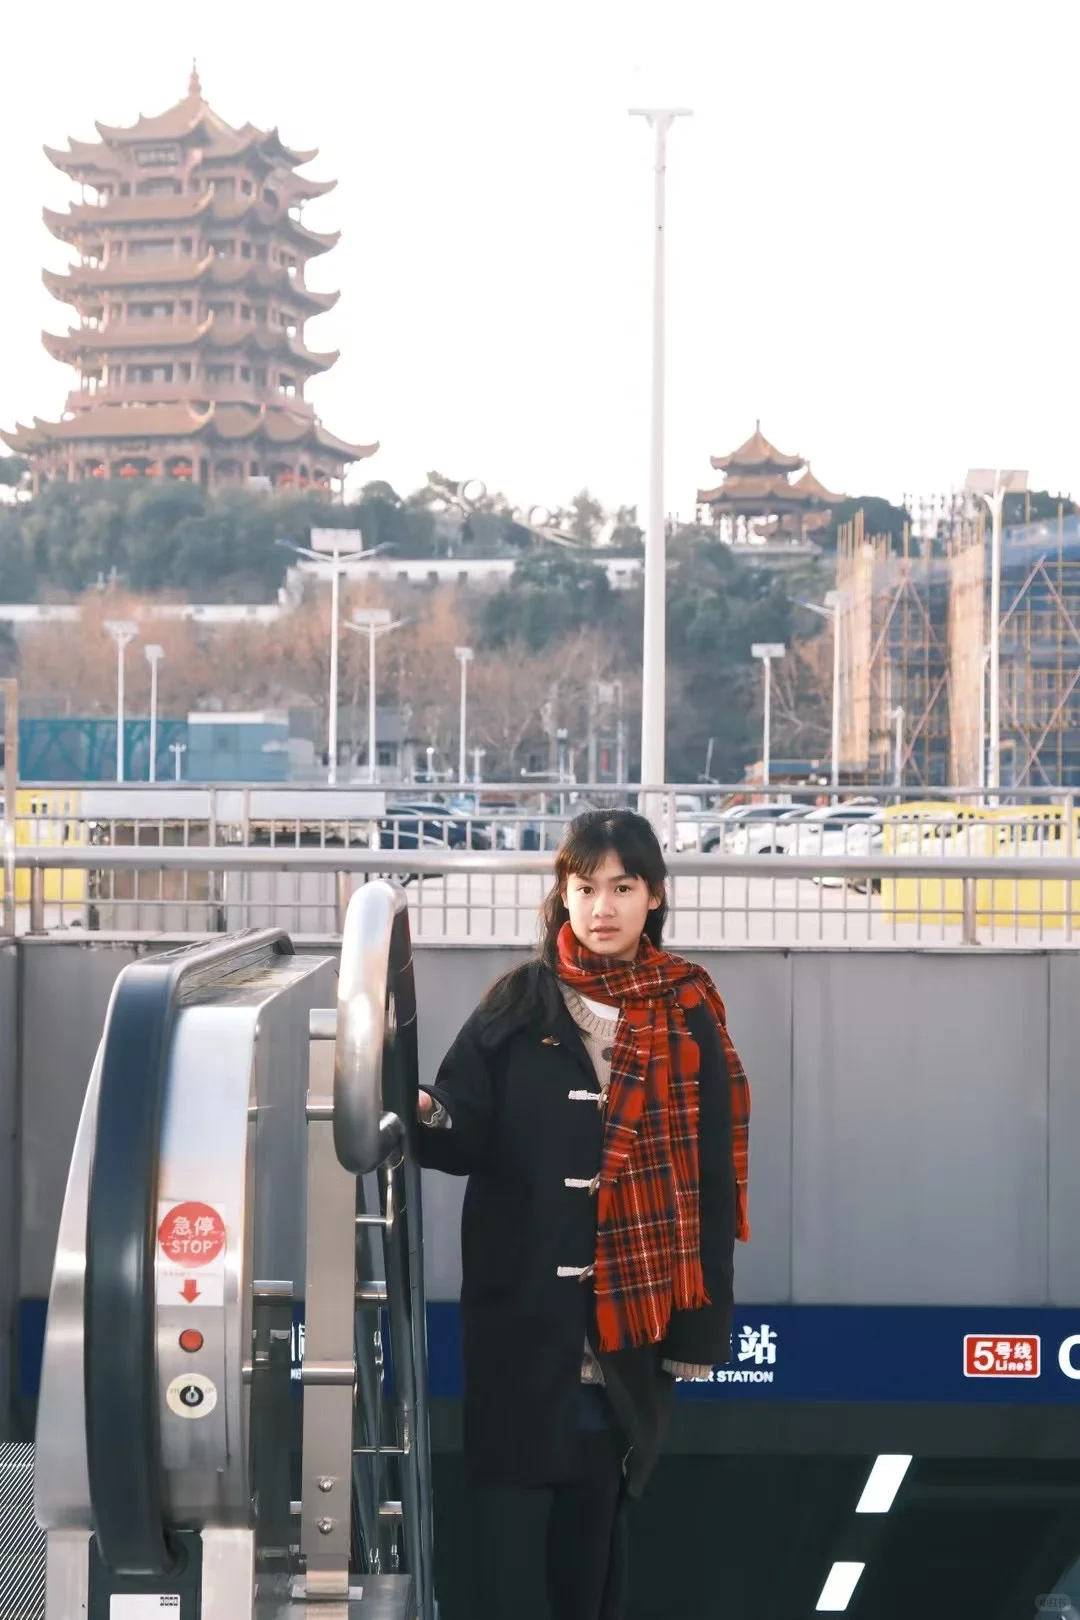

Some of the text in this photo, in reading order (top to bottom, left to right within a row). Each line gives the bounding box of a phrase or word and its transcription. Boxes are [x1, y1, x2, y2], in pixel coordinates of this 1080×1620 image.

[172, 1215, 215, 1236] 急停
[171, 1240, 213, 1254] STOP
[716, 1370, 774, 1383] STATION
